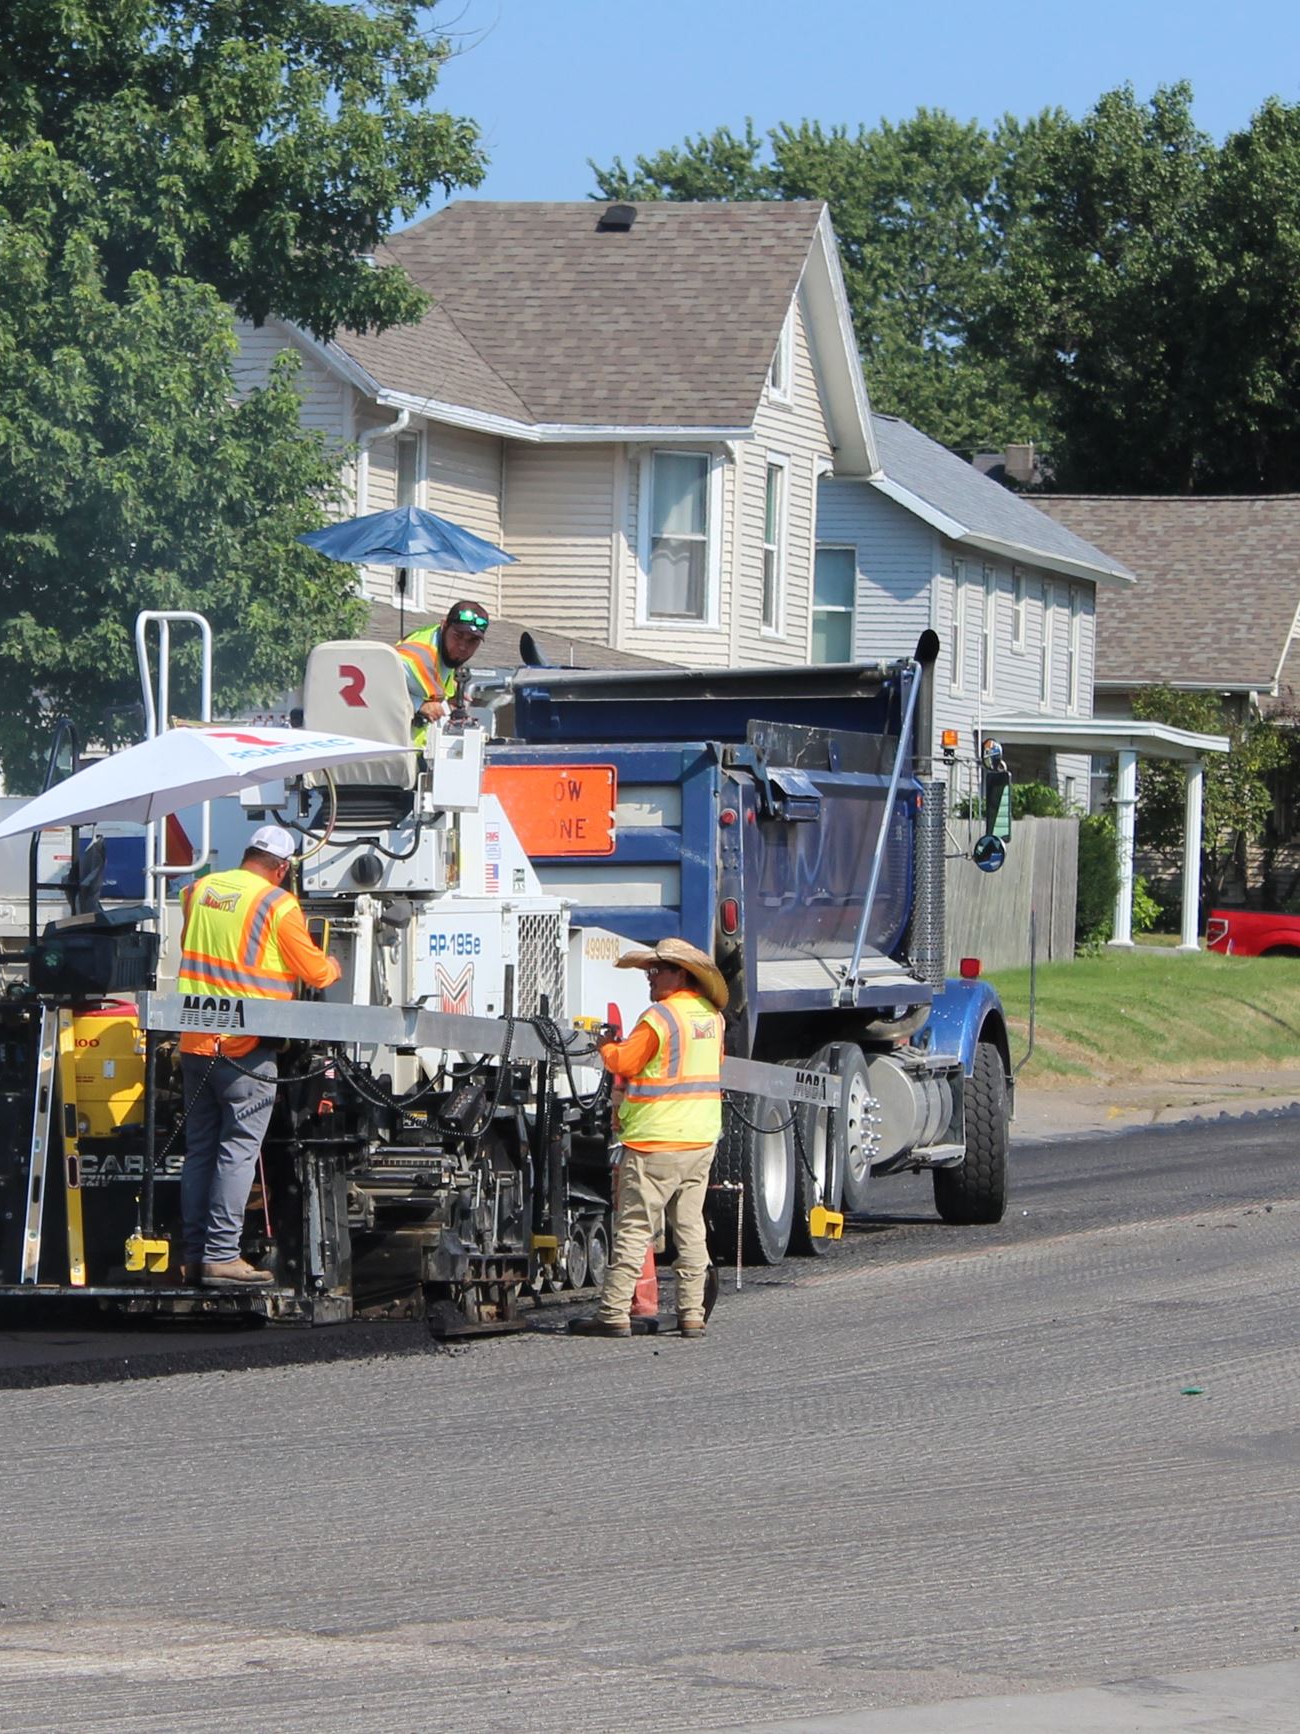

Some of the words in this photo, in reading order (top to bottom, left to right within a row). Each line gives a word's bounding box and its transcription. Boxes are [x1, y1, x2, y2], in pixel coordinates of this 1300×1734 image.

[228, 738, 354, 760] ROADTEC
[429, 933, 481, 957] RP-195e
[180, 995, 245, 1028] MOBA
